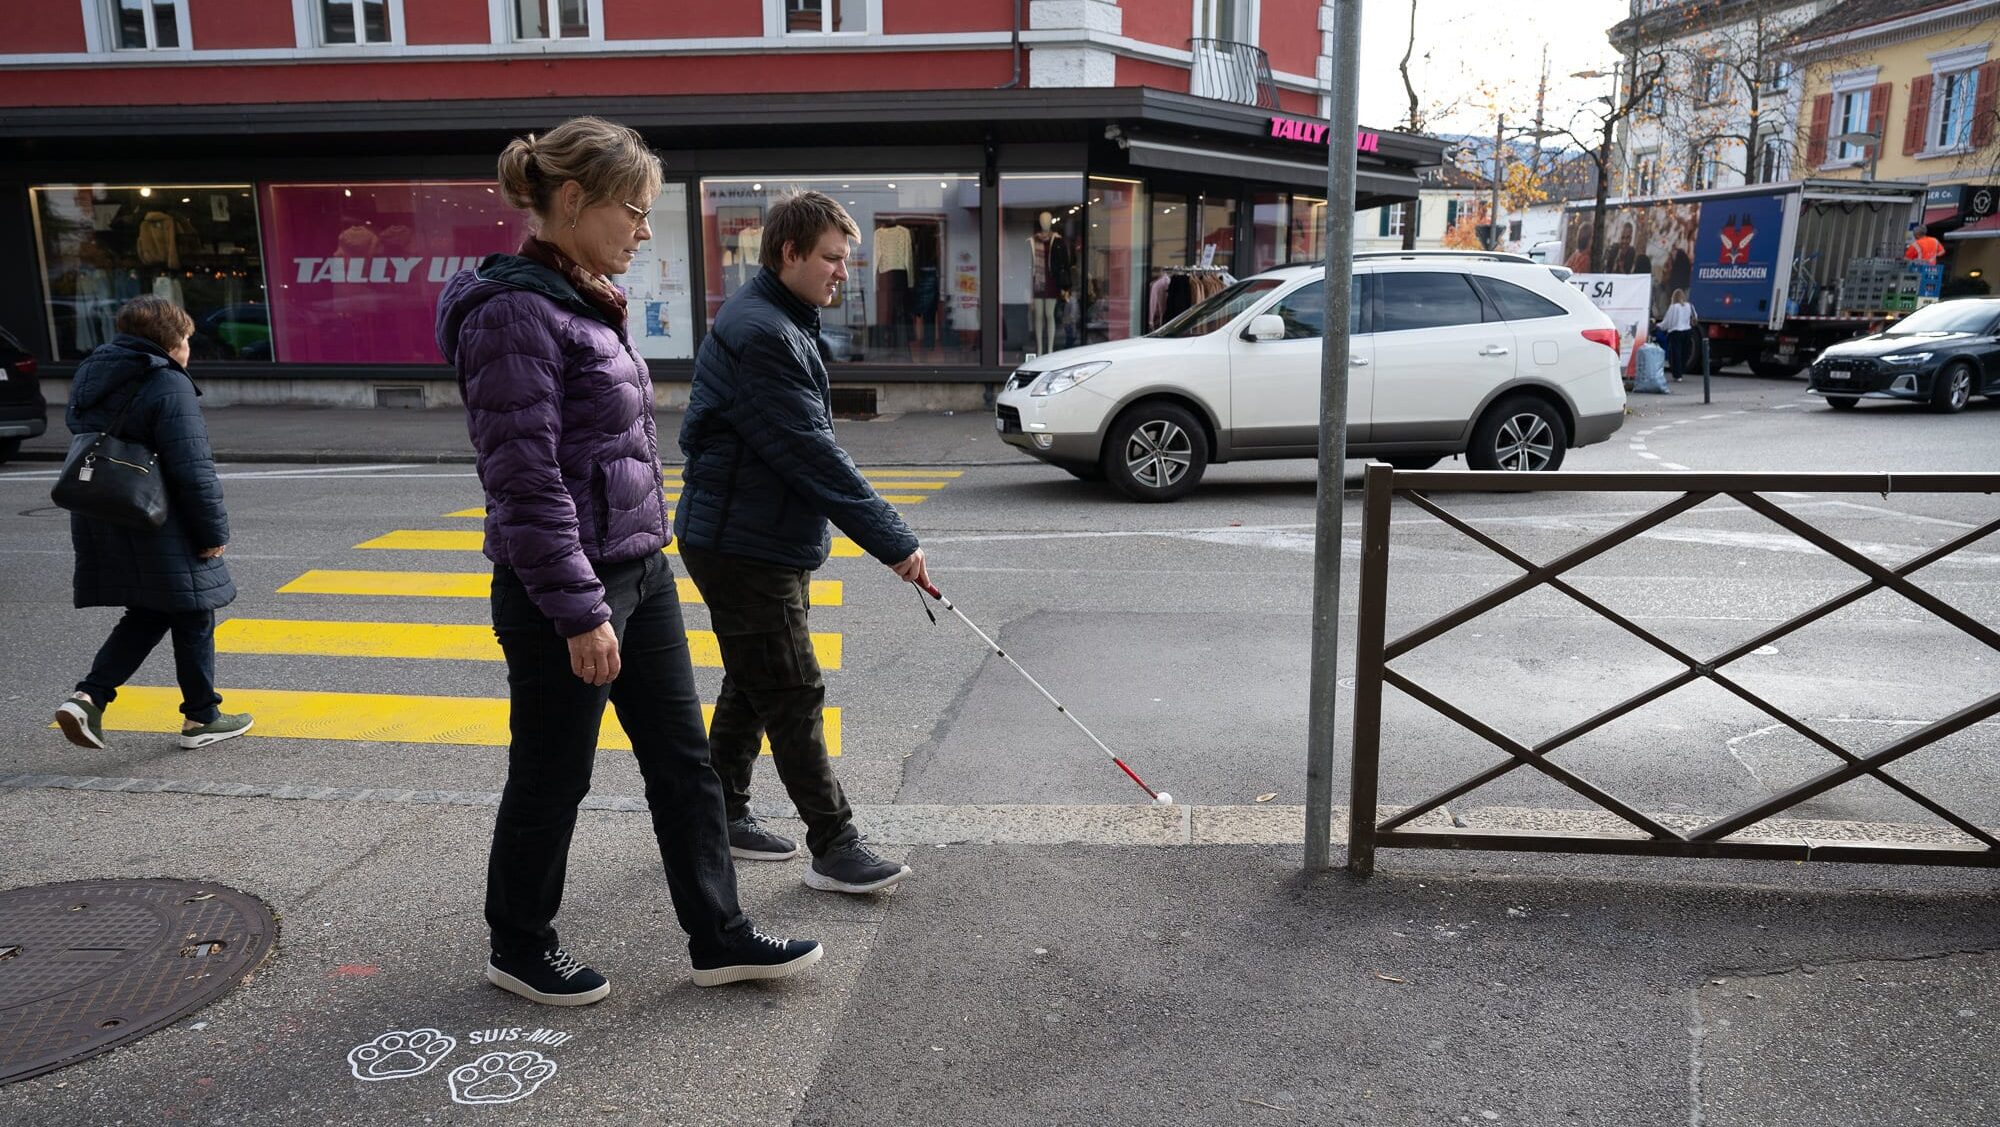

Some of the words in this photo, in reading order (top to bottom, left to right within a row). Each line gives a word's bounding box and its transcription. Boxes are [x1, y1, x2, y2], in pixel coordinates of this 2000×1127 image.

[1271, 117, 1328, 144] TALLY
[293, 257, 424, 283] TALLY
[1698, 265, 1768, 279] FELDSCHLÖSSCHEN
[1569, 281, 1589, 293] T
[1592, 281, 1613, 298] SA
[469, 1027, 573, 1048] SUIS-MOI
